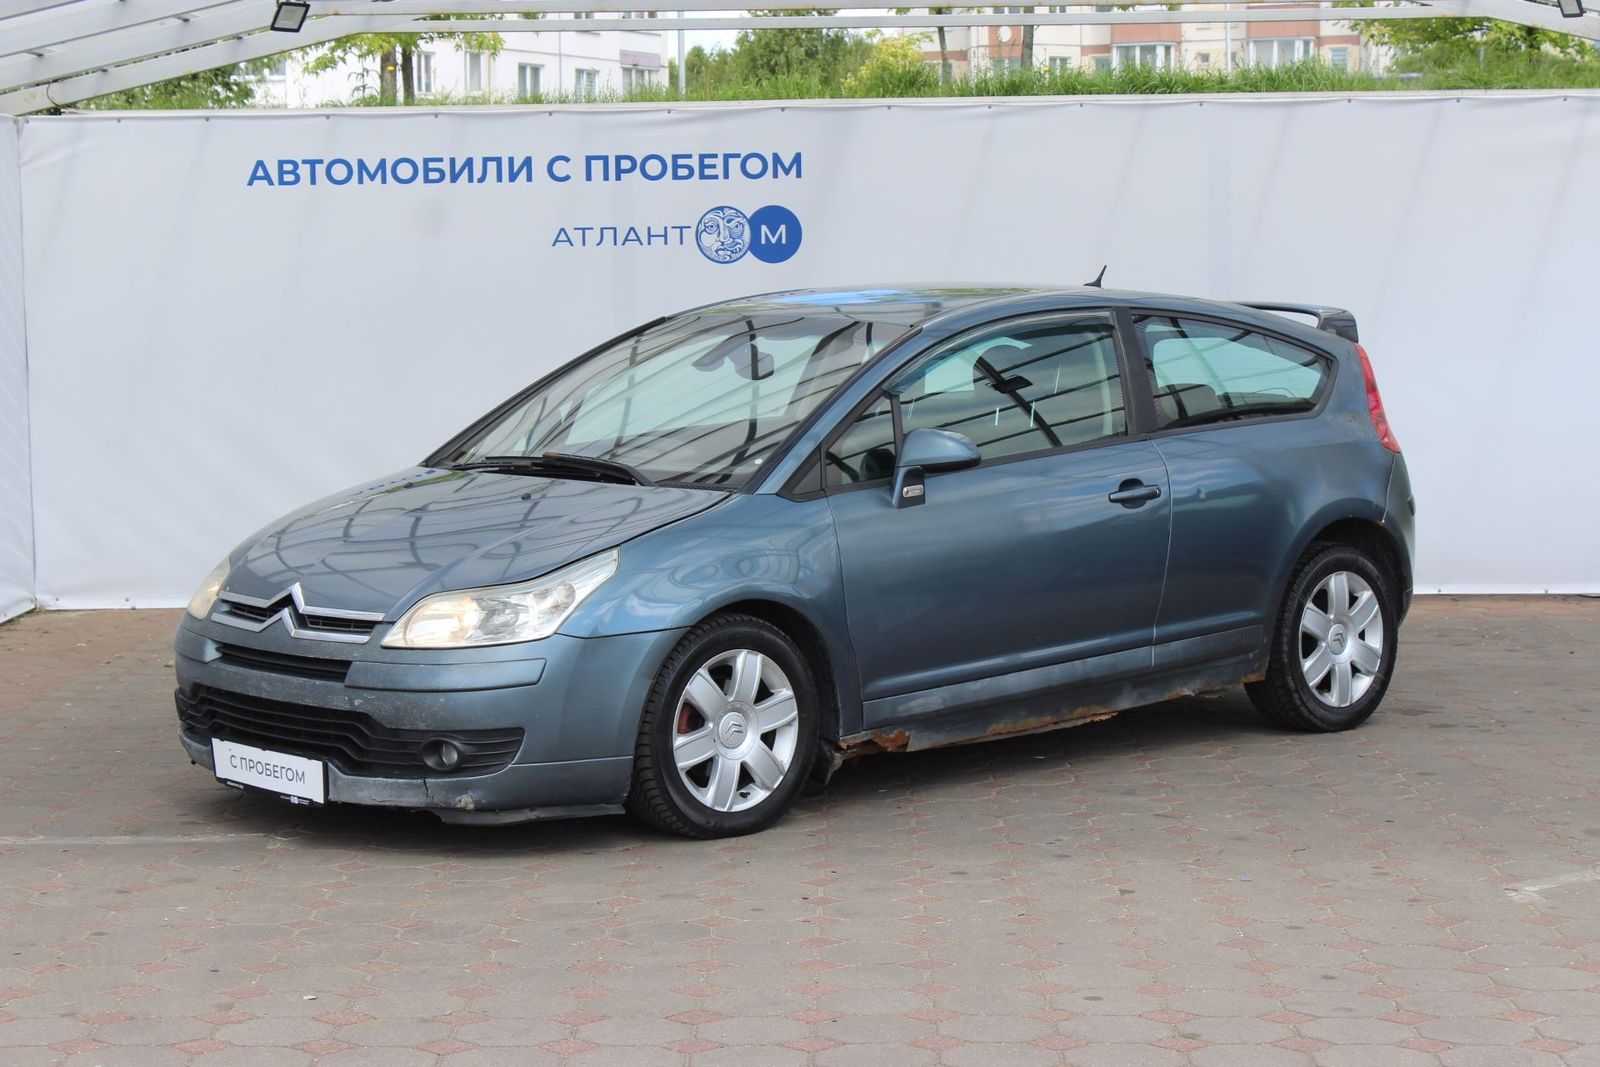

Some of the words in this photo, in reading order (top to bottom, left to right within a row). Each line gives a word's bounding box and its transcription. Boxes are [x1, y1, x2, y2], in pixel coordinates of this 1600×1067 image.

[247, 155, 533, 187] АВТОМОБИЛИ
[547, 155, 572, 182] С
[584, 152, 803, 182] ПРОБЕГОМ
[551, 226, 692, 247] АТЛАНТ
[229, 754, 238, 769] С
[239, 758, 306, 784] ПРОБЕГОМ
